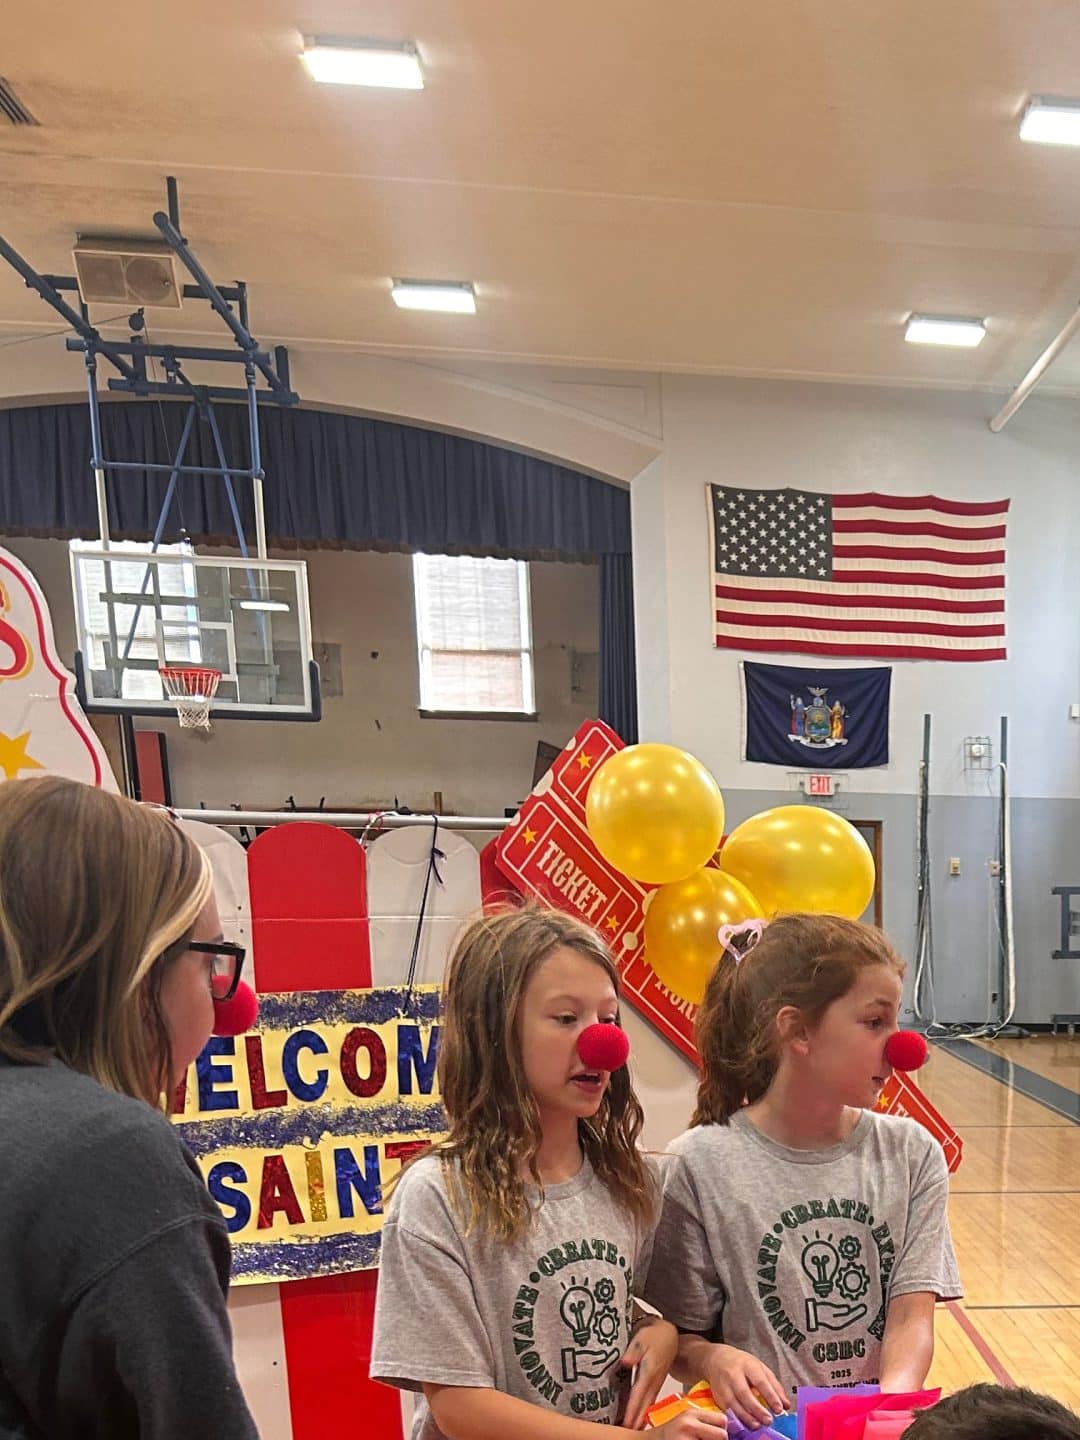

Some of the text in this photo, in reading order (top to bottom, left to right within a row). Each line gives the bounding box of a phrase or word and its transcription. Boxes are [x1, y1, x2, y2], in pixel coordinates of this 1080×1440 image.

[810, 775, 831, 793] EXIT
[536, 839, 608, 920] TICKET
[172, 1024, 442, 1115] ELCOM
[781, 1198, 870, 1229] CREATE
[537, 1239, 618, 1277] CREATE
[757, 1233, 806, 1352] INNOVATE
[512, 1284, 563, 1406] INNOVATE
[831, 1368, 852, 1380] 2025
